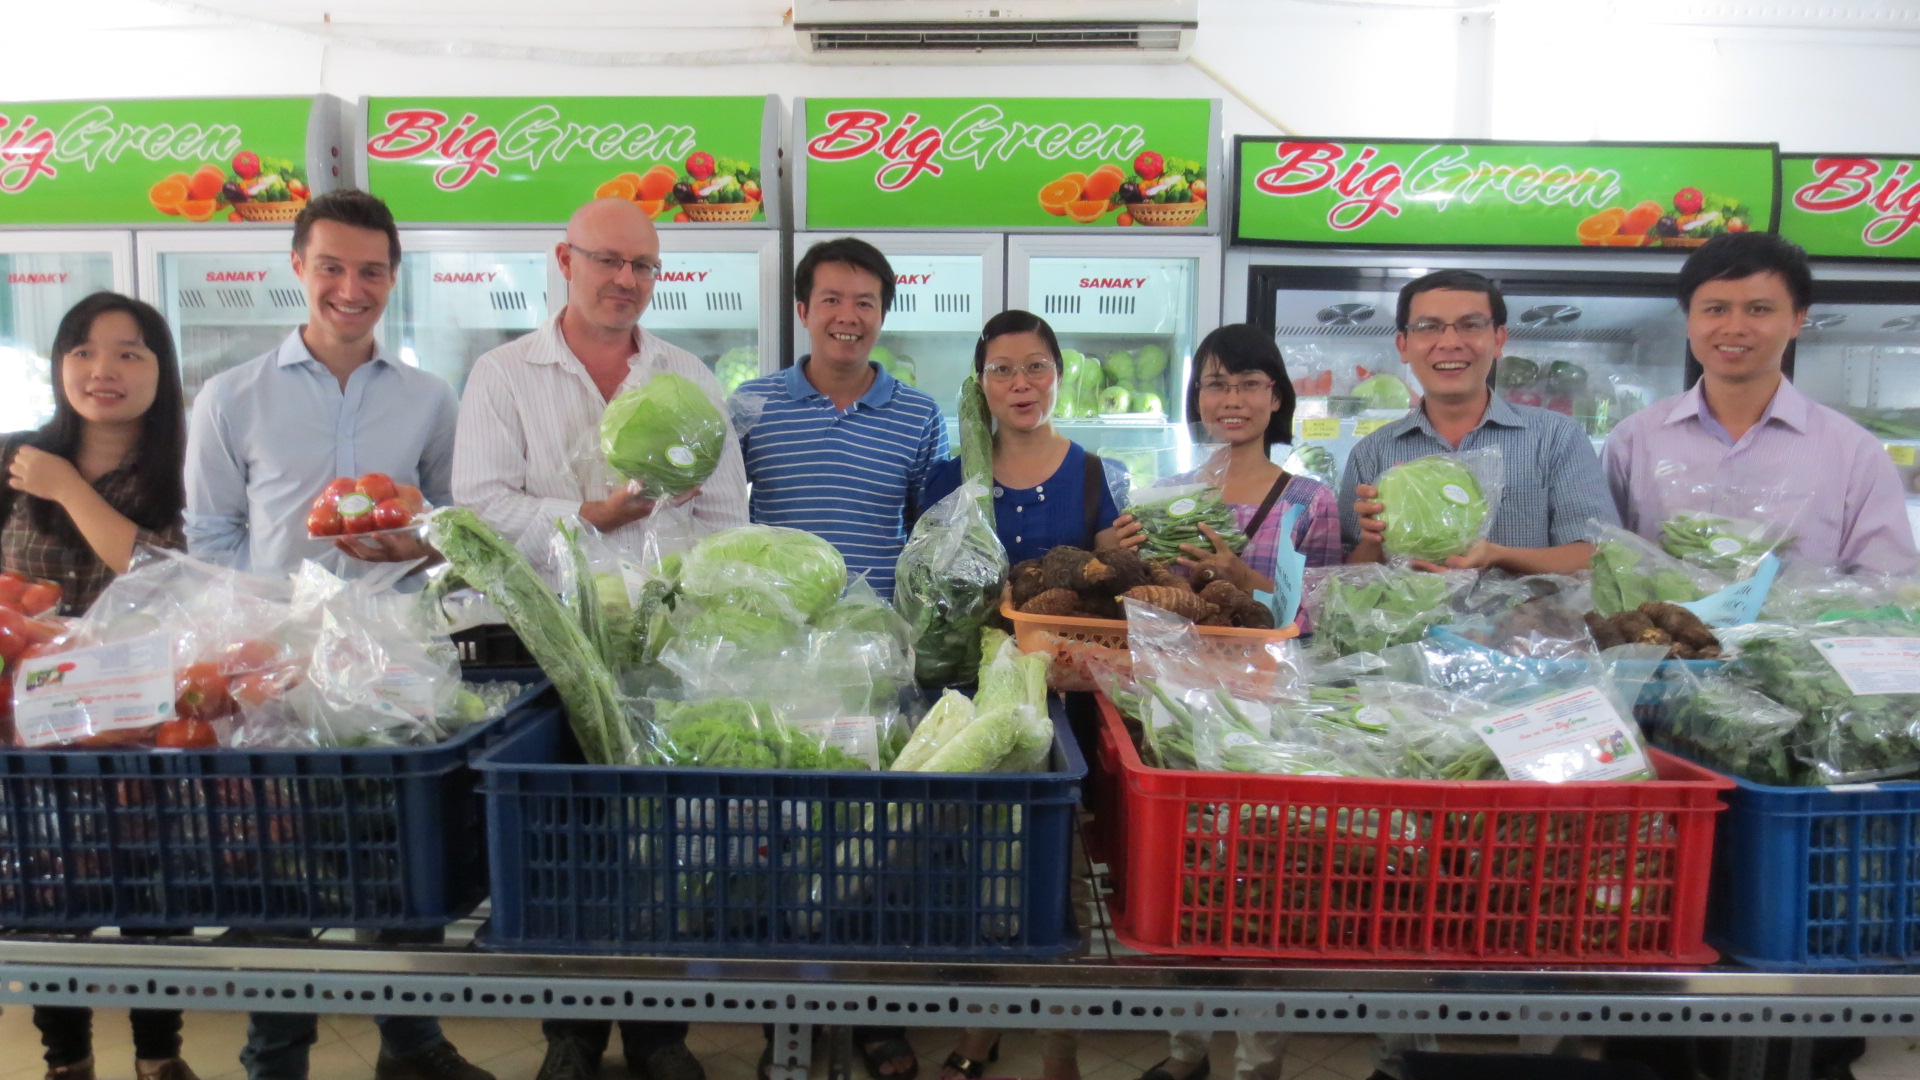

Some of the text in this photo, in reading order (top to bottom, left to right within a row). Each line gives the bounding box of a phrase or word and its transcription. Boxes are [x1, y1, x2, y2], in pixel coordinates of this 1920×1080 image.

[0, 105, 241, 194] ig Green
[367, 105, 696, 192] Big Green
[807, 104, 1145, 192] Big Green
[1255, 142, 1621, 232] Big Green
[205, 271, 267, 282] SANAKY
[433, 271, 497, 283] SANAKY
[656, 271, 708, 282] ANAKY
[1079, 277, 1146, 289] SANAKY
